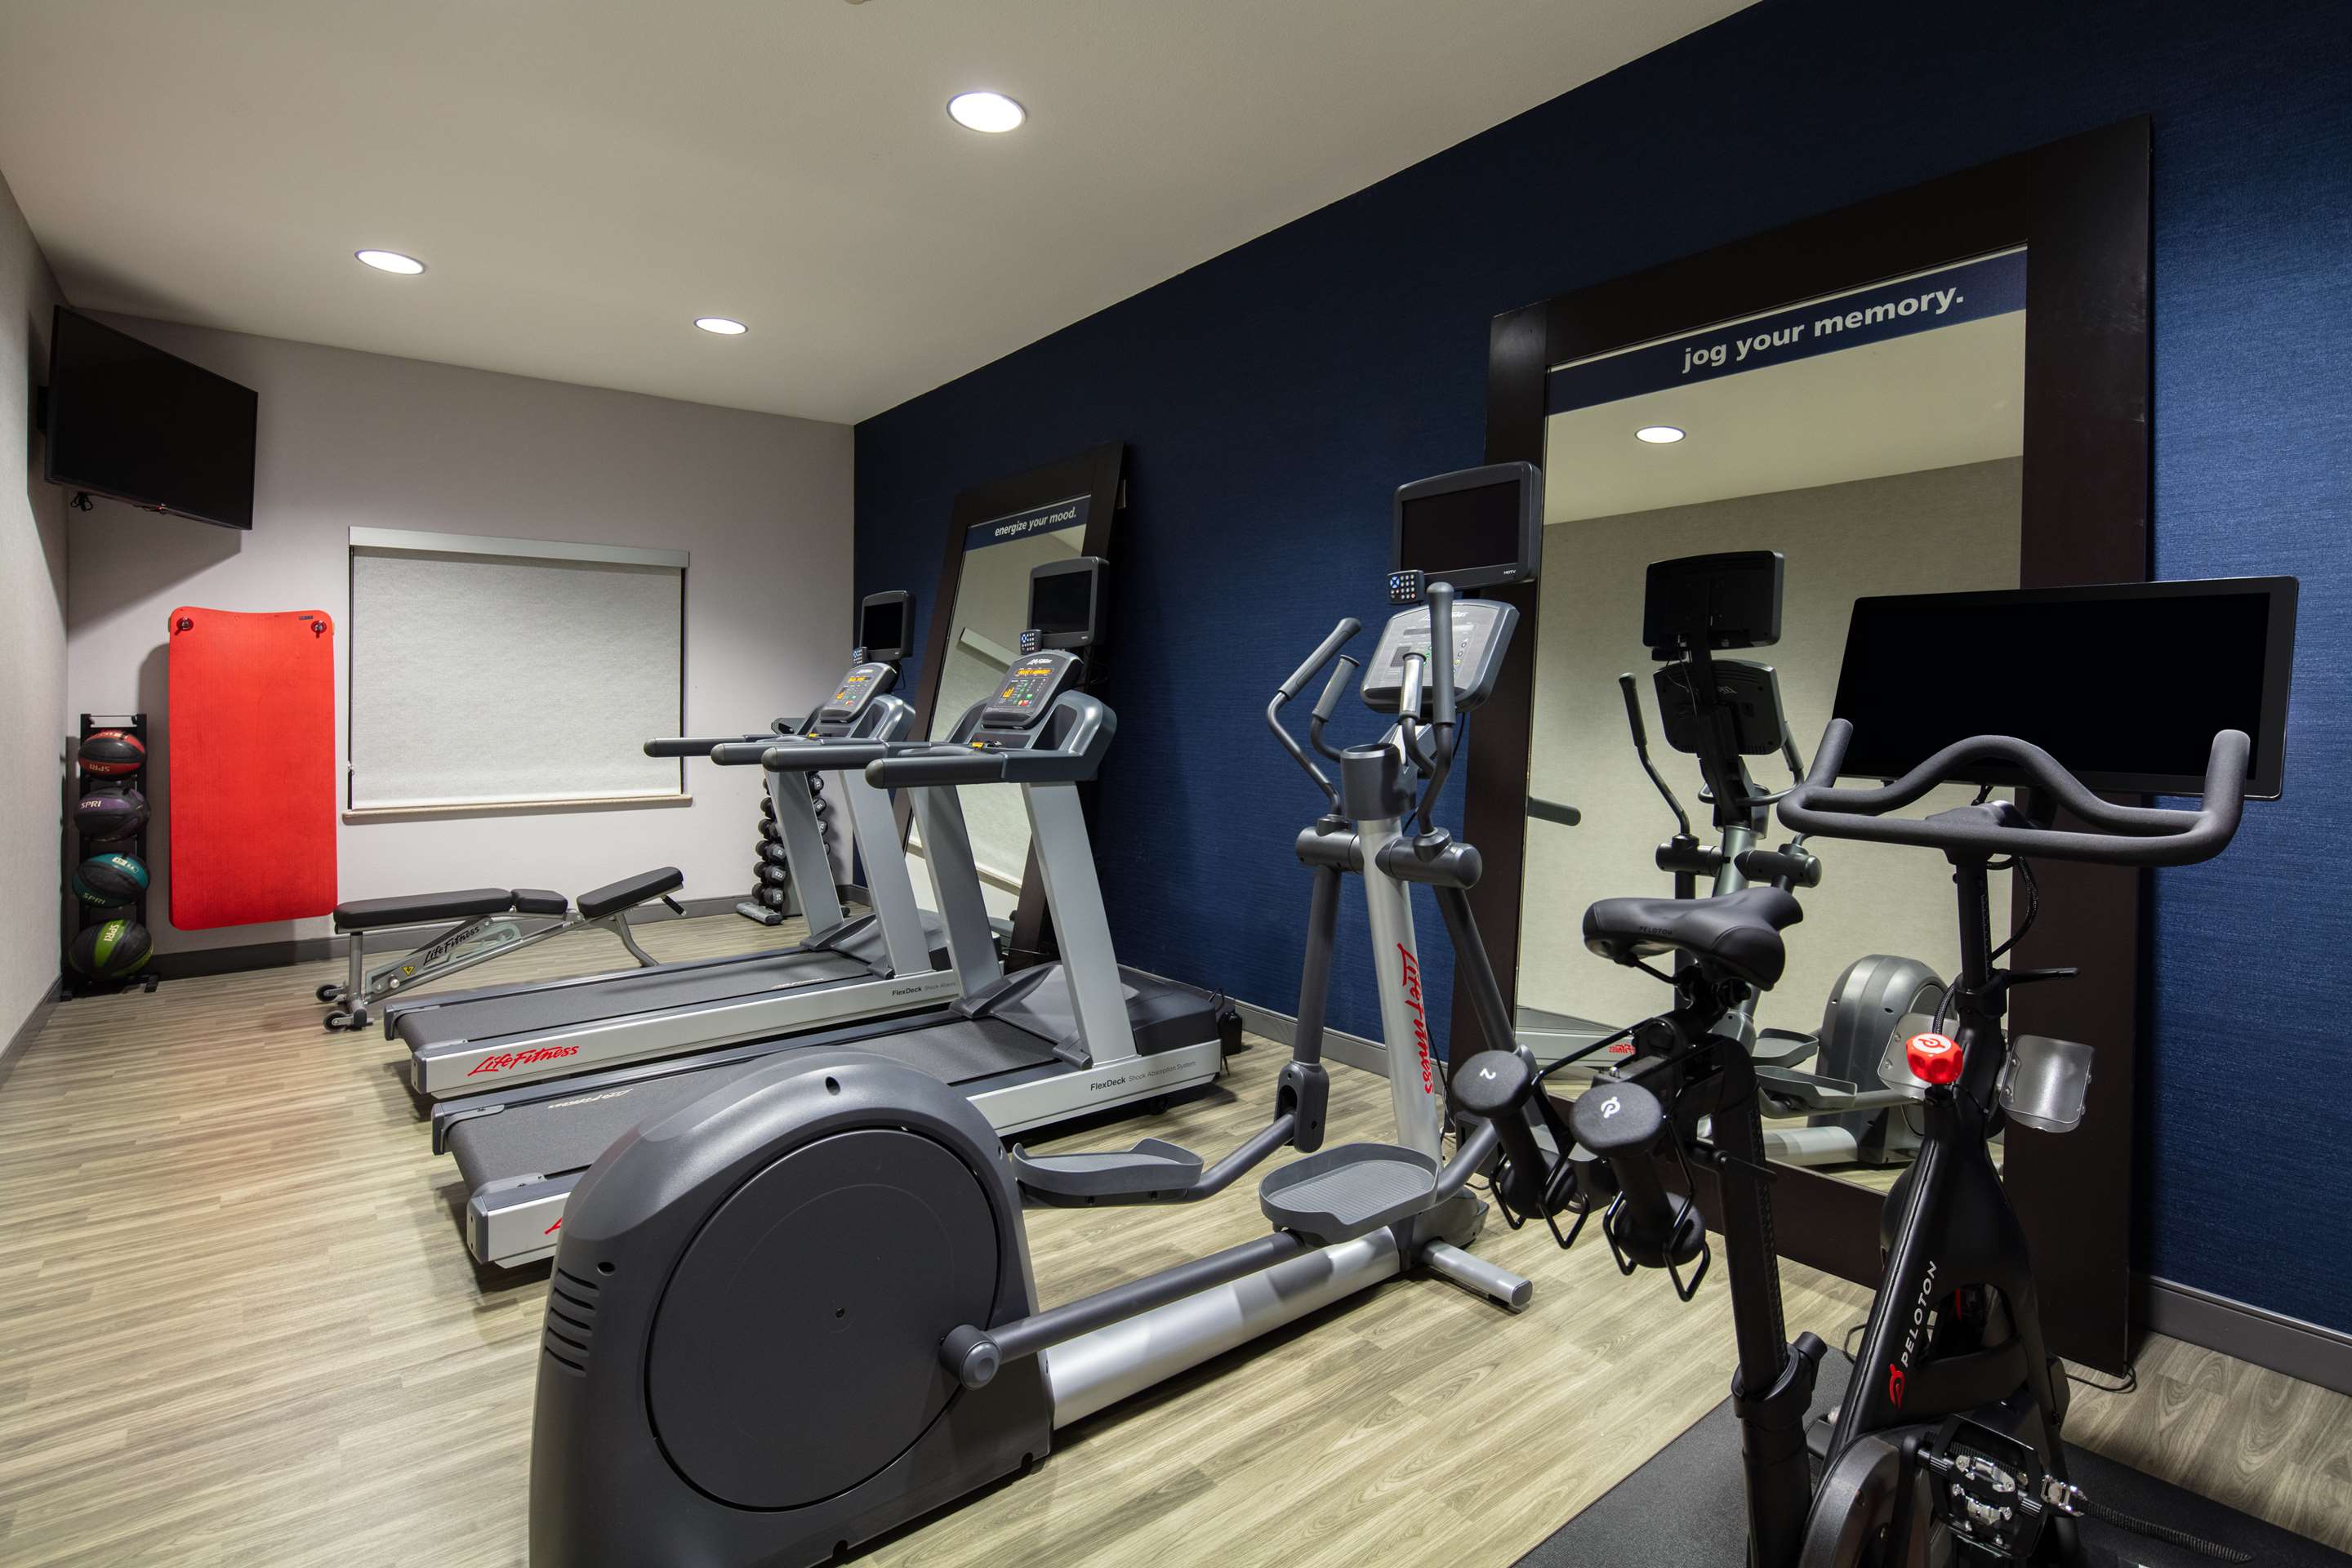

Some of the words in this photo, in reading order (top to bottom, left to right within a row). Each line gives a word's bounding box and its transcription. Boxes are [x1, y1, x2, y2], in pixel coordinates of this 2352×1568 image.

[1682, 343, 1727, 374] jog
[1735, 324, 1805, 362] your
[1814, 287, 1964, 338] memory.
[995, 520, 1027, 537] energize
[1028, 515, 1049, 531] your
[1049, 506, 1076, 523] mood.
[81, 800, 102, 810] SPRI
[83, 893, 105, 905] SPRI
[104, 924, 119, 942] SPRI
[1090, 1076, 1126, 1091] FlexDeck
[1900, 1260, 1938, 1369] PELOTON
